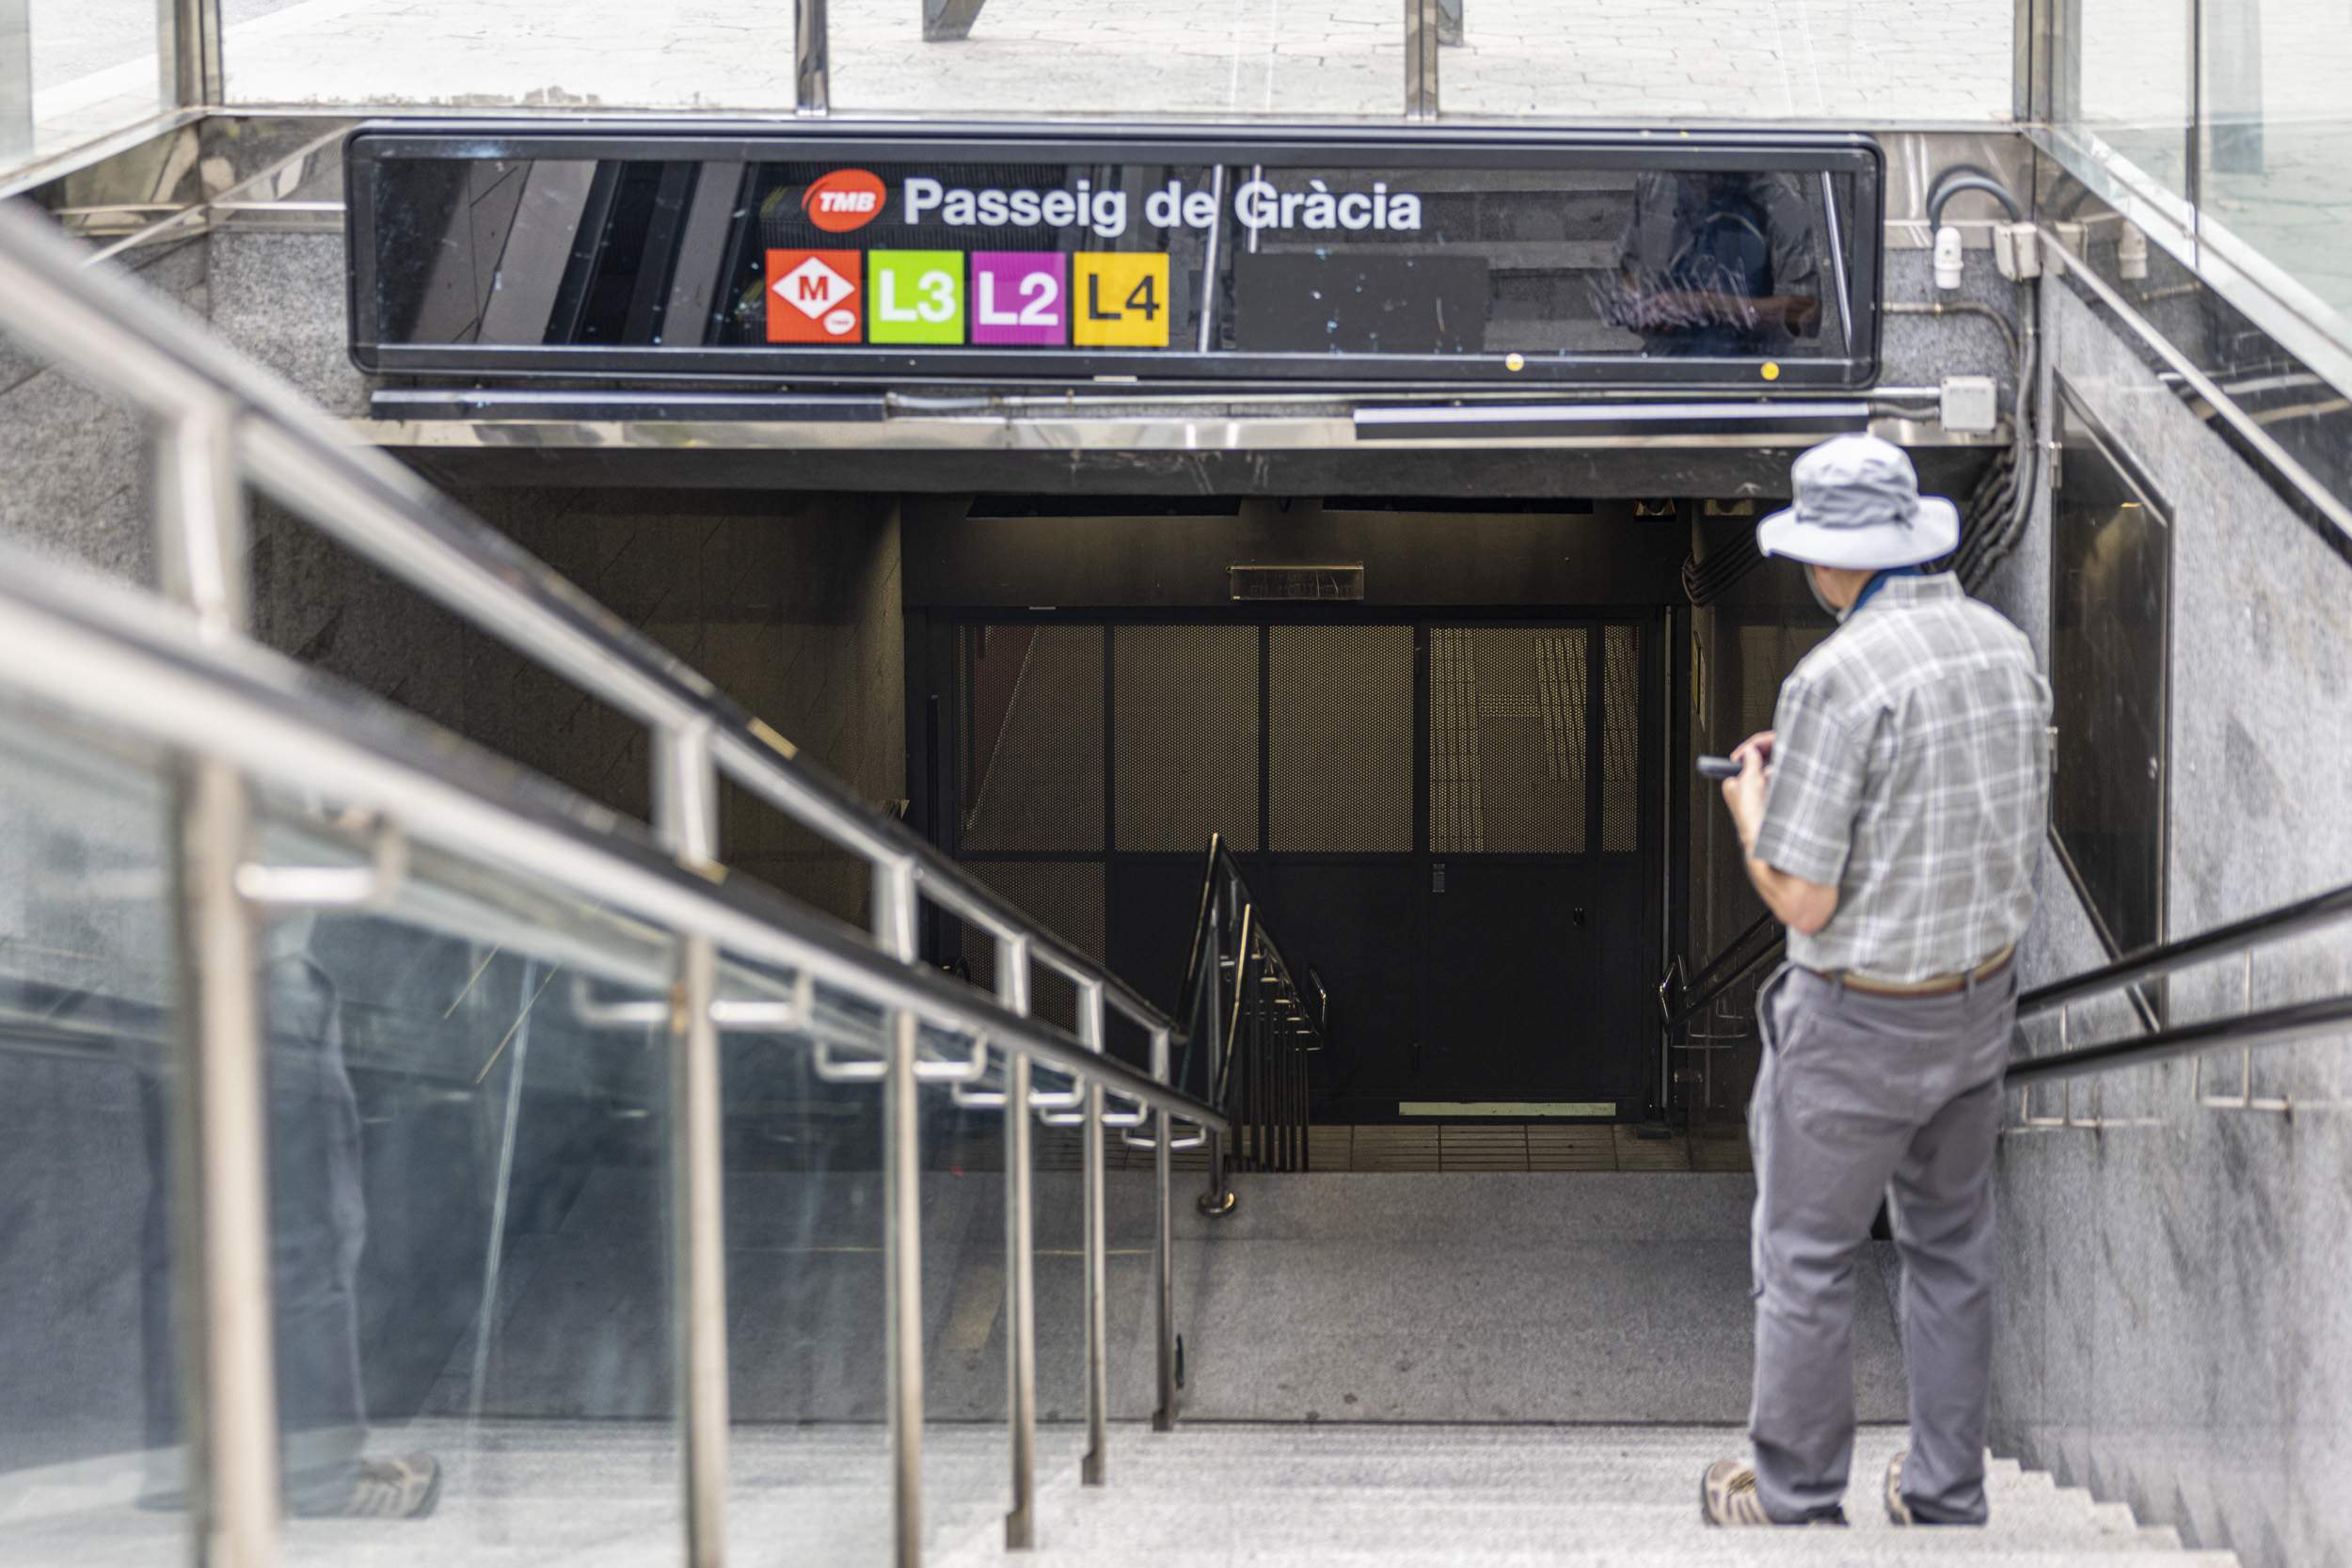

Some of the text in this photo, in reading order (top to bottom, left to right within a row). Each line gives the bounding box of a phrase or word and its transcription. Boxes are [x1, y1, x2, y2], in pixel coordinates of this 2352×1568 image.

[818, 190, 877, 214] TMB
[904, 178, 1422, 237] Passeig de Gràcia
[798, 276, 828, 301] M
[878, 269, 956, 322] L3
[978, 273, 1059, 325] L2
[1088, 274, 1161, 321] L4
